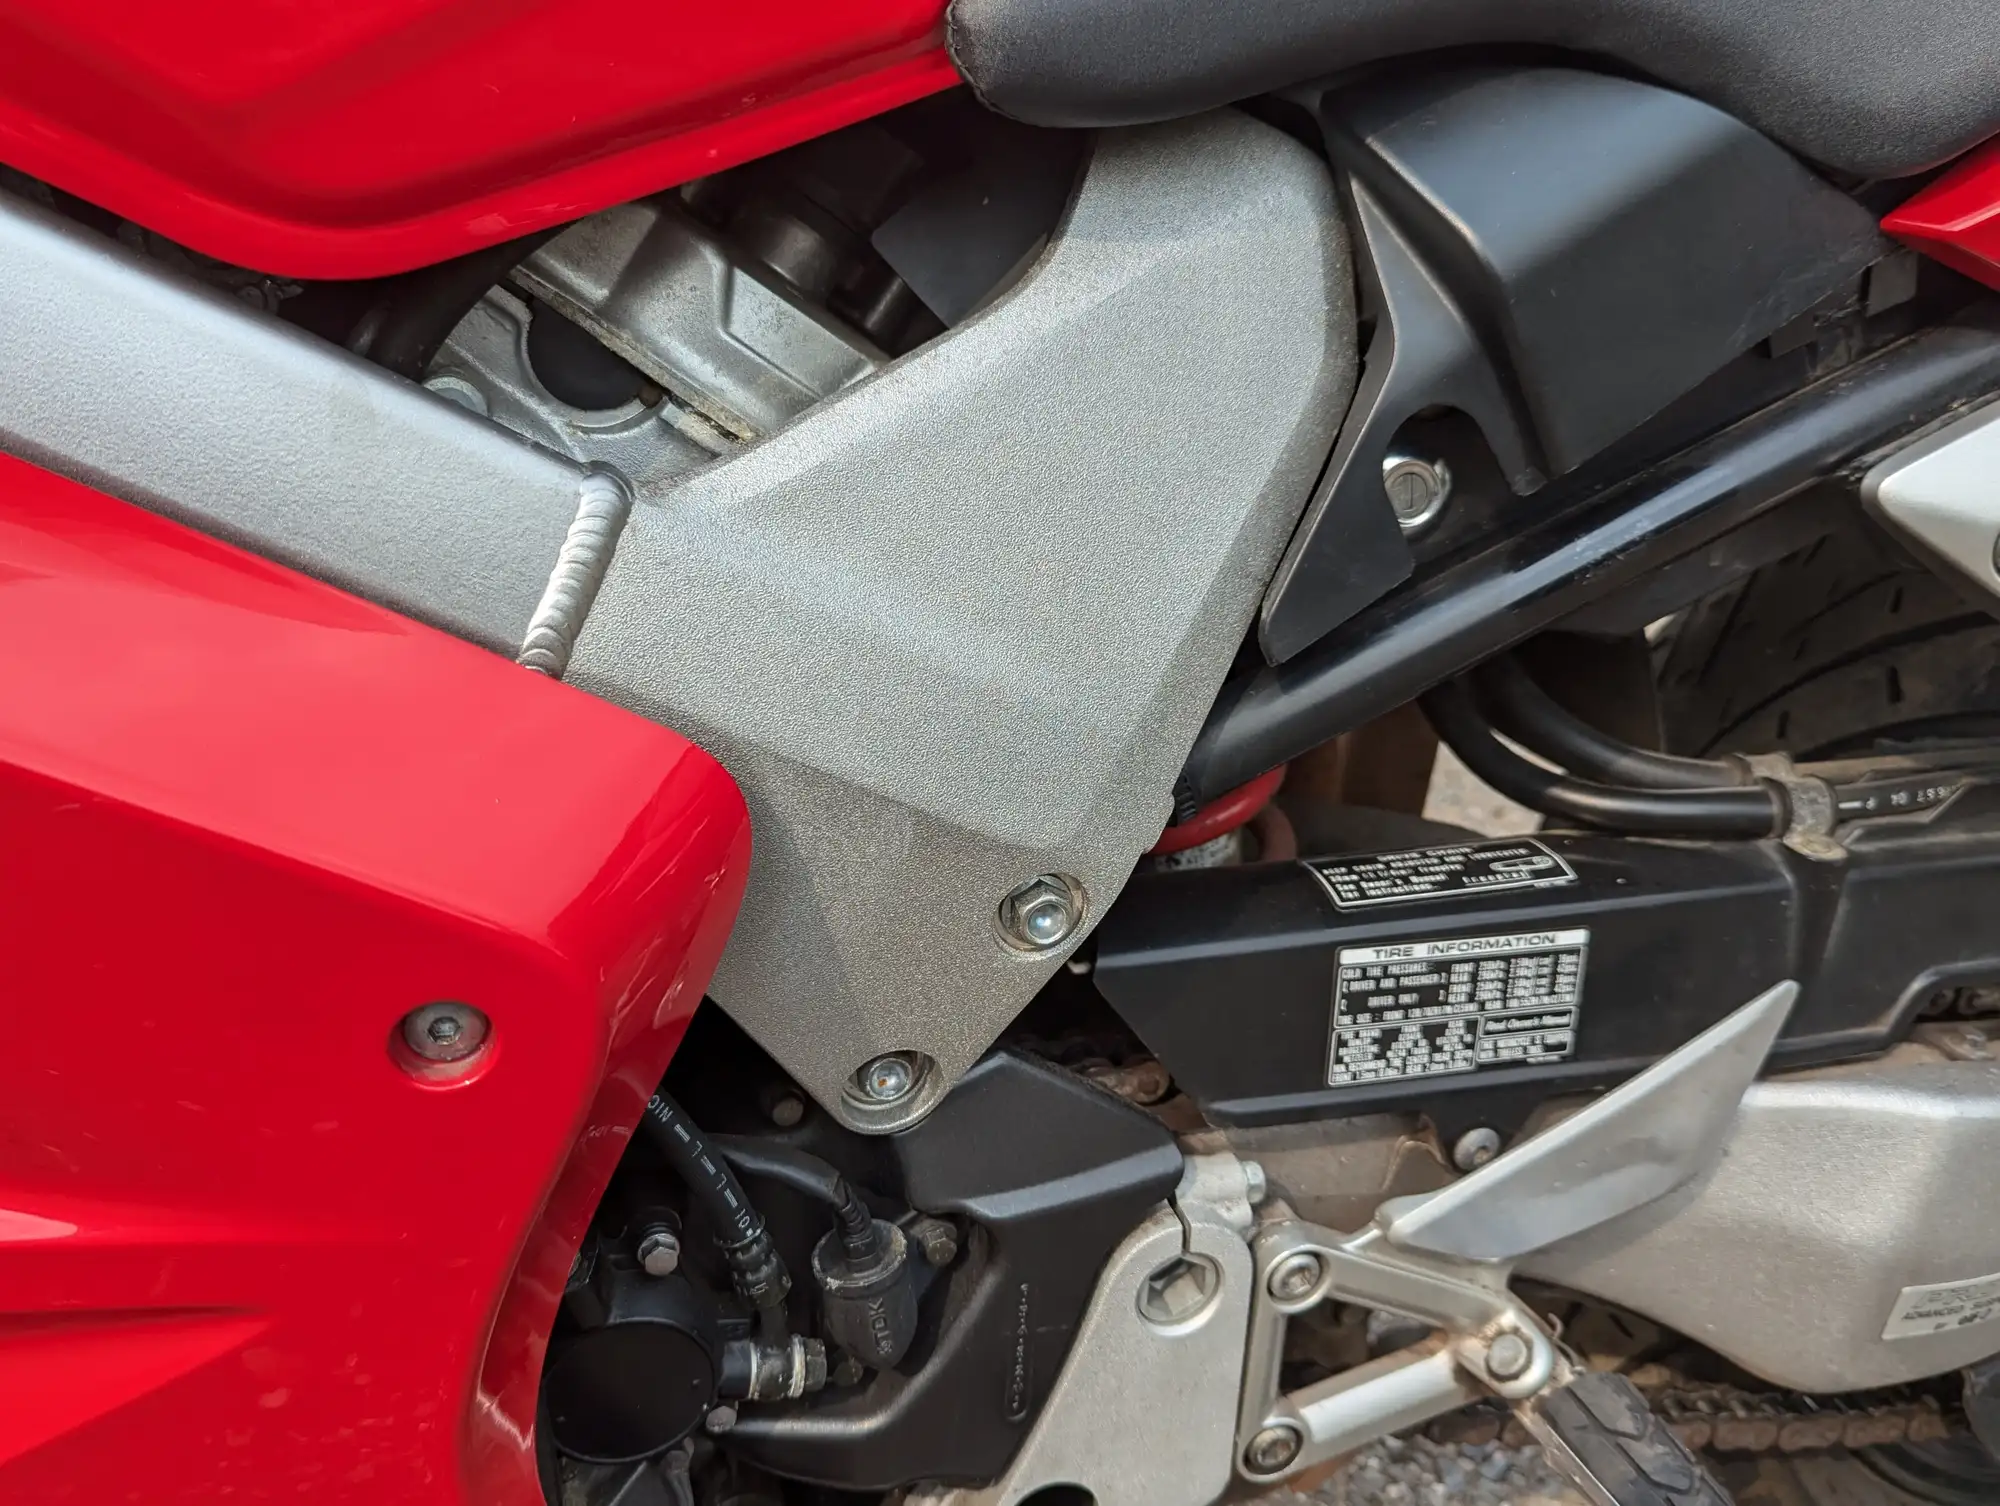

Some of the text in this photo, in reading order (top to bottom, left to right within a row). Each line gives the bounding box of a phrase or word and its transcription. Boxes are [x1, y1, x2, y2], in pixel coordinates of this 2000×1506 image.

[1372, 934, 1556, 959] TIRE INFORMATION
[868, 1297, 891, 1338] TDK
